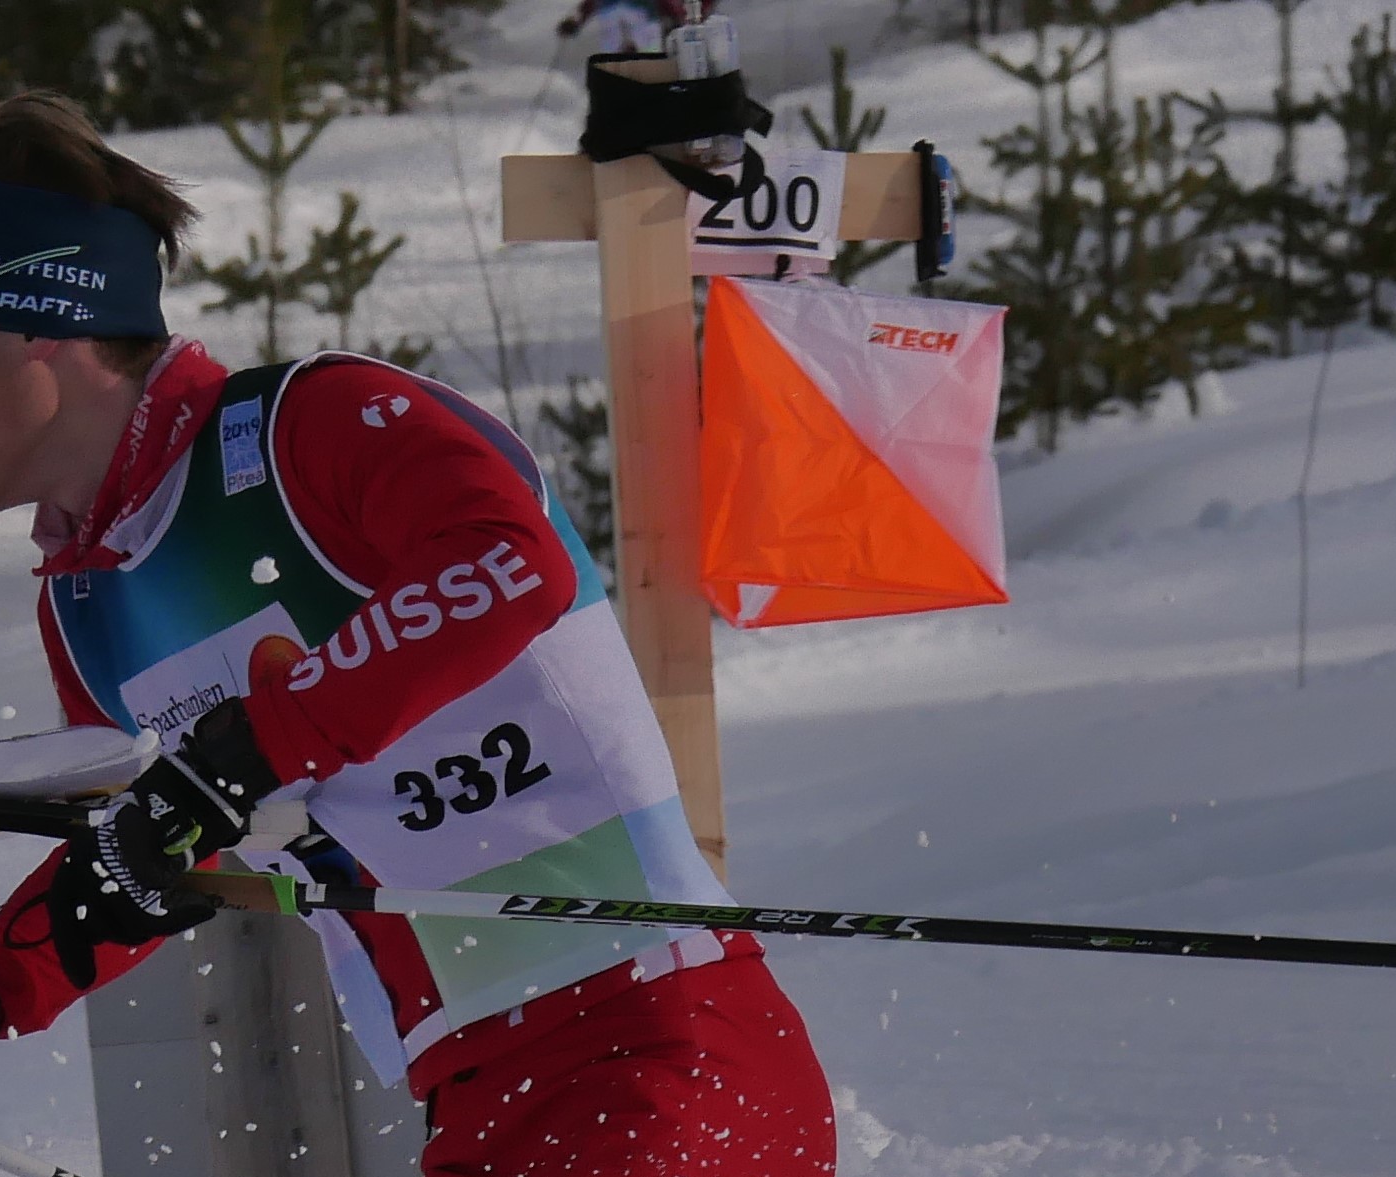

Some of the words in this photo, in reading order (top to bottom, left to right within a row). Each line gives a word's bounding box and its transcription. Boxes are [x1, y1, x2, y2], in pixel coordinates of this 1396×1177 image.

[699, 175, 819, 232] 200
[223, 416, 261, 442] 2019
[287, 541, 544, 692] SUISSE
[394, 722, 552, 832] 332
